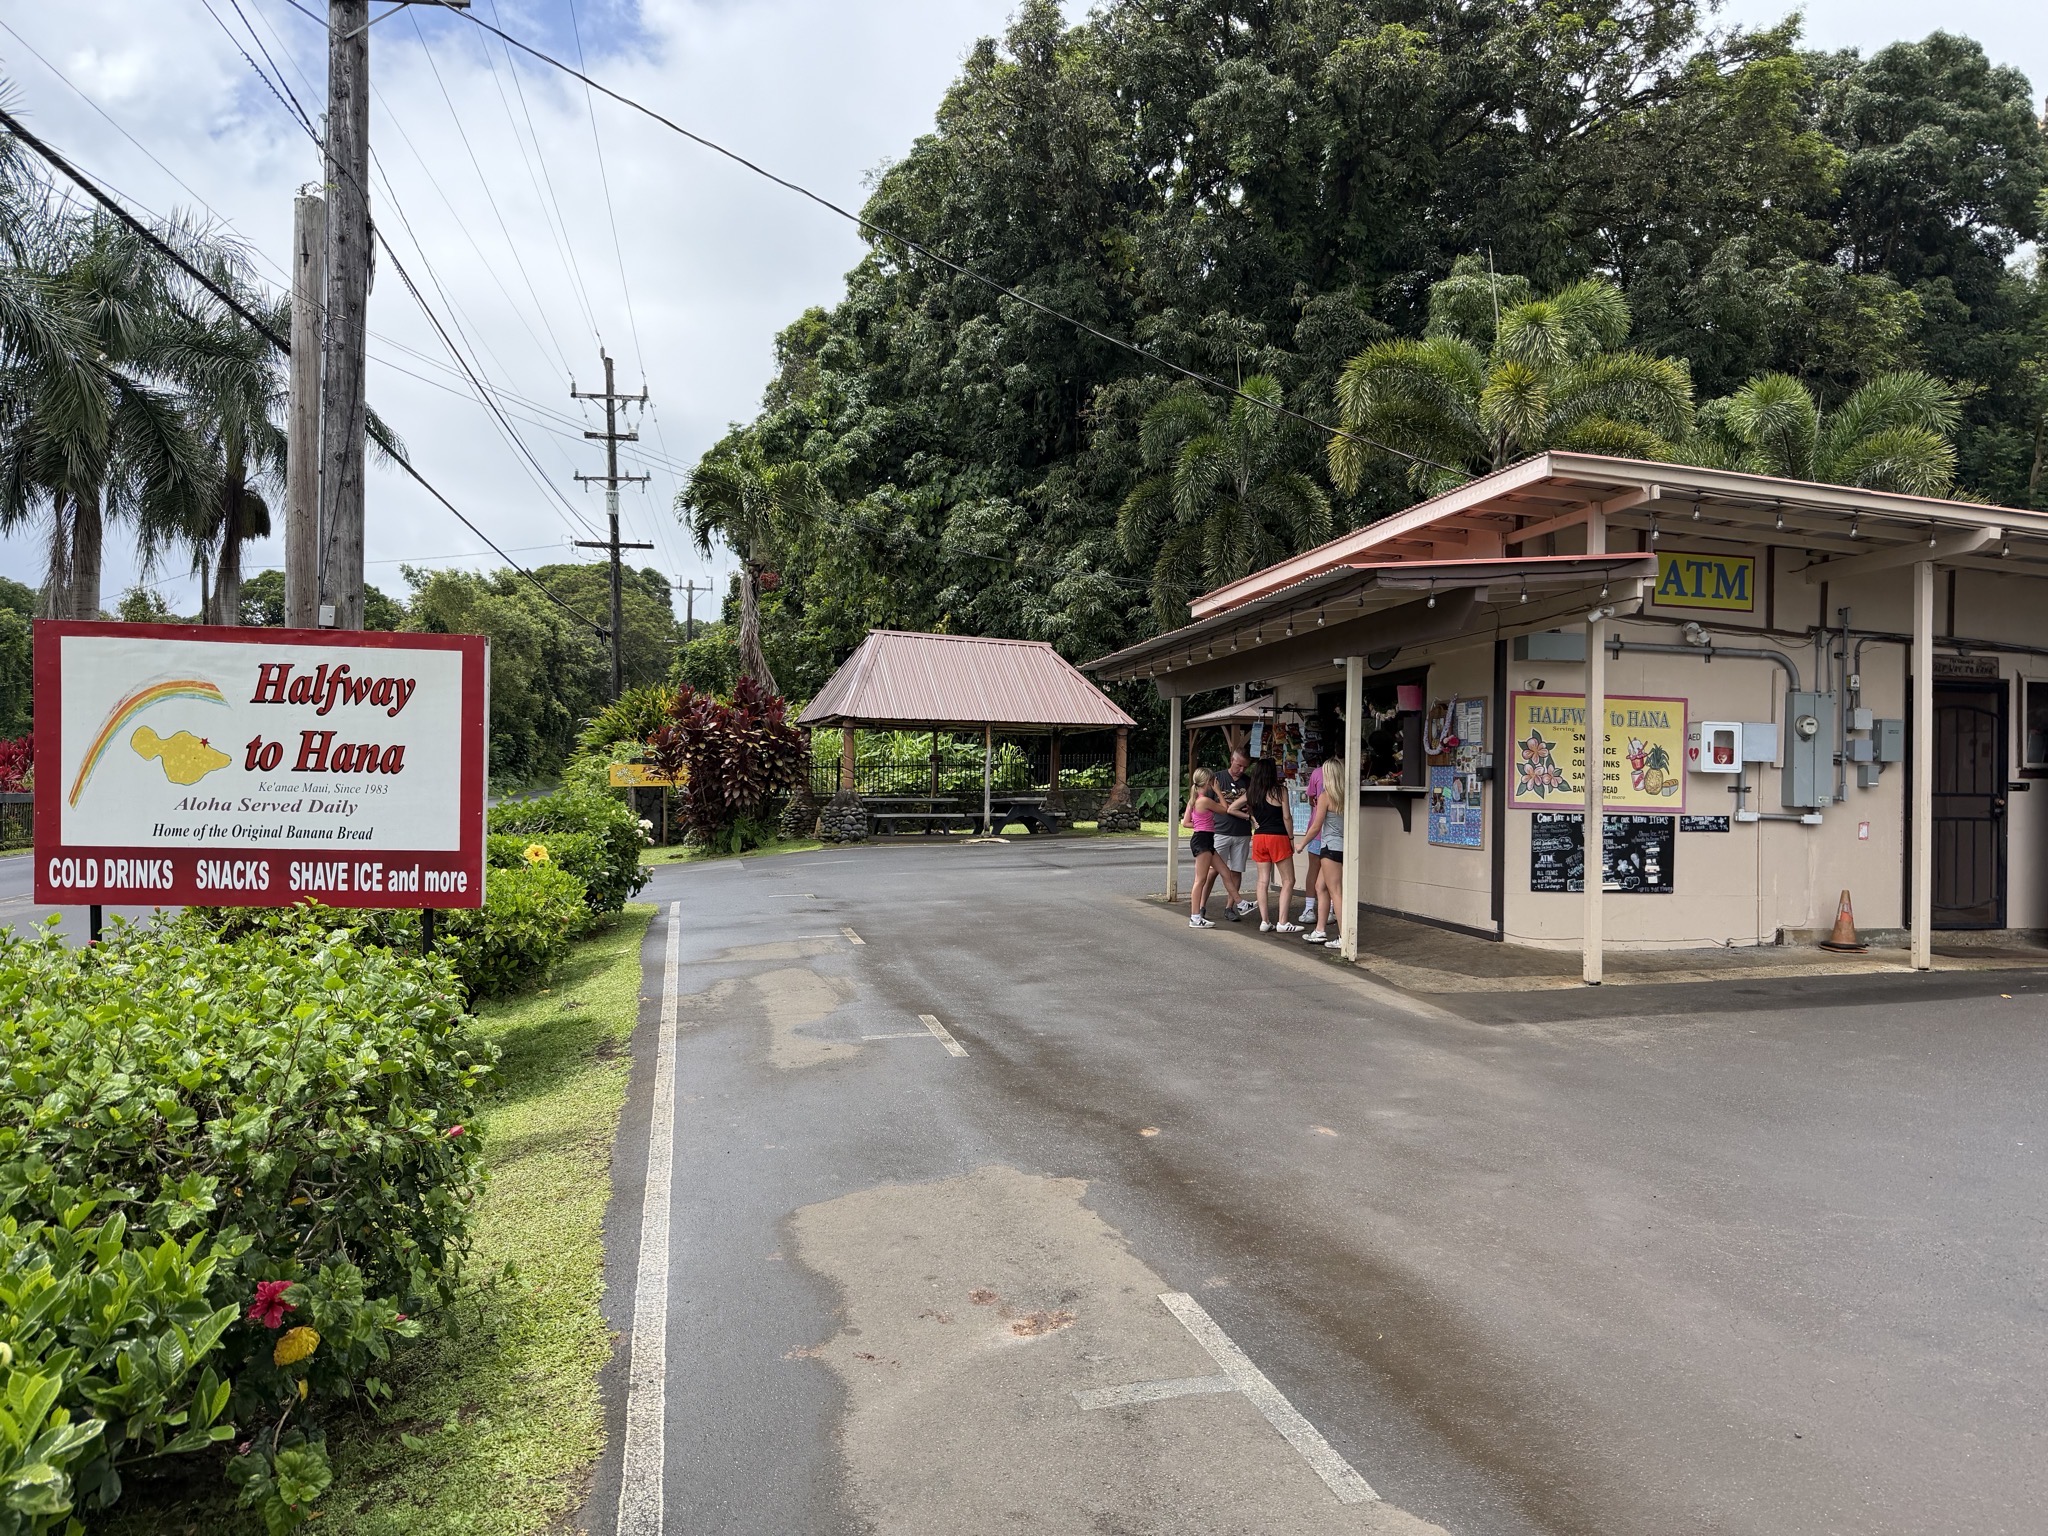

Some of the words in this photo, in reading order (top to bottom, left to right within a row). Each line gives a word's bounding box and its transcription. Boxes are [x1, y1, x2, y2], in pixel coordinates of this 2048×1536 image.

[1658, 559, 1749, 600] ATM
[250, 663, 416, 717] Halfway
[1528, 706, 1606, 725] HALFW
[1610, 711, 1624, 726] to
[1627, 710, 1670, 728] HANA
[1688, 733, 1701, 741] AED
[244, 734, 284, 772] to
[291, 730, 405, 774] Hana
[1572, 759, 1586, 767] COL
[1603, 761, 1620, 769] INKS
[258, 781, 299, 793] Ke'anae
[302, 783, 331, 795] Maui,
[334, 783, 361, 794] Since
[364, 784, 389, 795] 1983
[1602, 786, 1618, 794] READ
[173, 797, 232, 812] Aloha
[237, 798, 303, 813] Served
[307, 799, 358, 817] Daily
[152, 823, 190, 838] Home
[193, 824, 208, 841] of
[208, 824, 228, 838] the
[231, 824, 283, 841] Original
[286, 826, 333, 839] Banana
[336, 826, 374, 840] Bread
[1540, 854, 1554, 862] ATM
[49, 857, 98, 888] COLD
[104, 859, 173, 889] DRINKS
[196, 860, 269, 890] SNACKS
[289, 861, 348, 891] SHAVE
[354, 862, 383, 892] ICE
[388, 864, 419, 892] and
[424, 868, 467, 893] more
